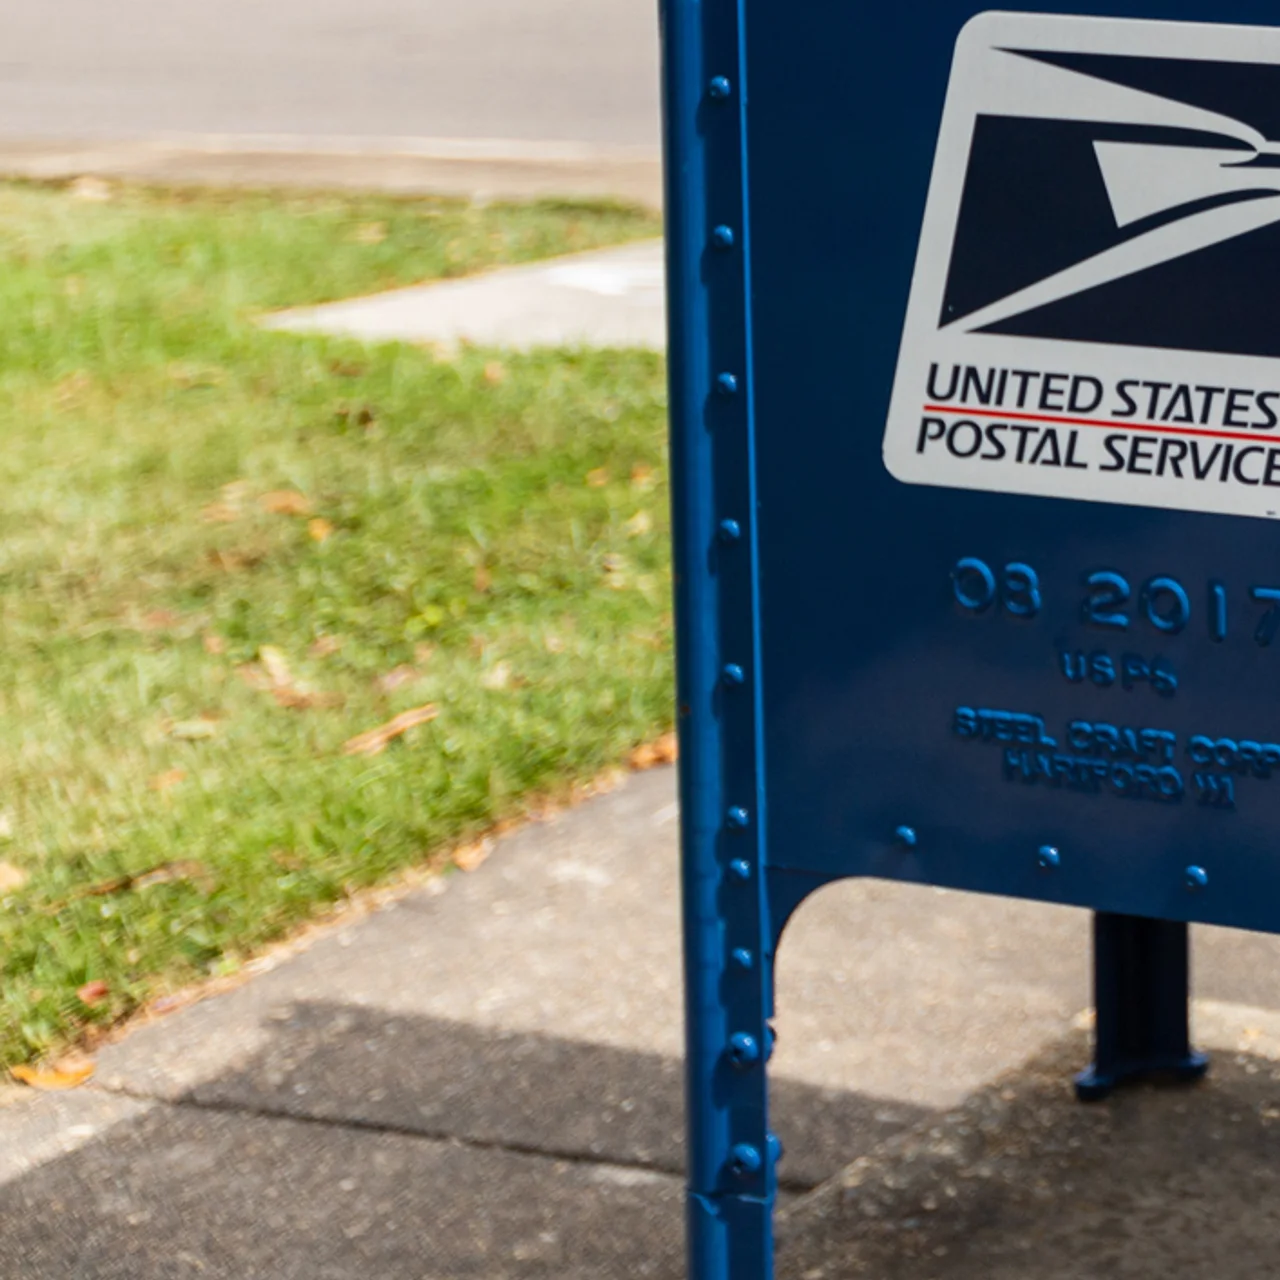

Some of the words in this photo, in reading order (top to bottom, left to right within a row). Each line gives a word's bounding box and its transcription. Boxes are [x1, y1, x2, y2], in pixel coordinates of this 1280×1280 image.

[925, 362, 1104, 413] UNITED
[1111, 380, 1280, 430] STATES
[916, 417, 1088, 469] POSTAL
[953, 557, 1043, 616] 08
[1062, 651, 1178, 695] USPS
[954, 706, 1058, 749] STEEL
